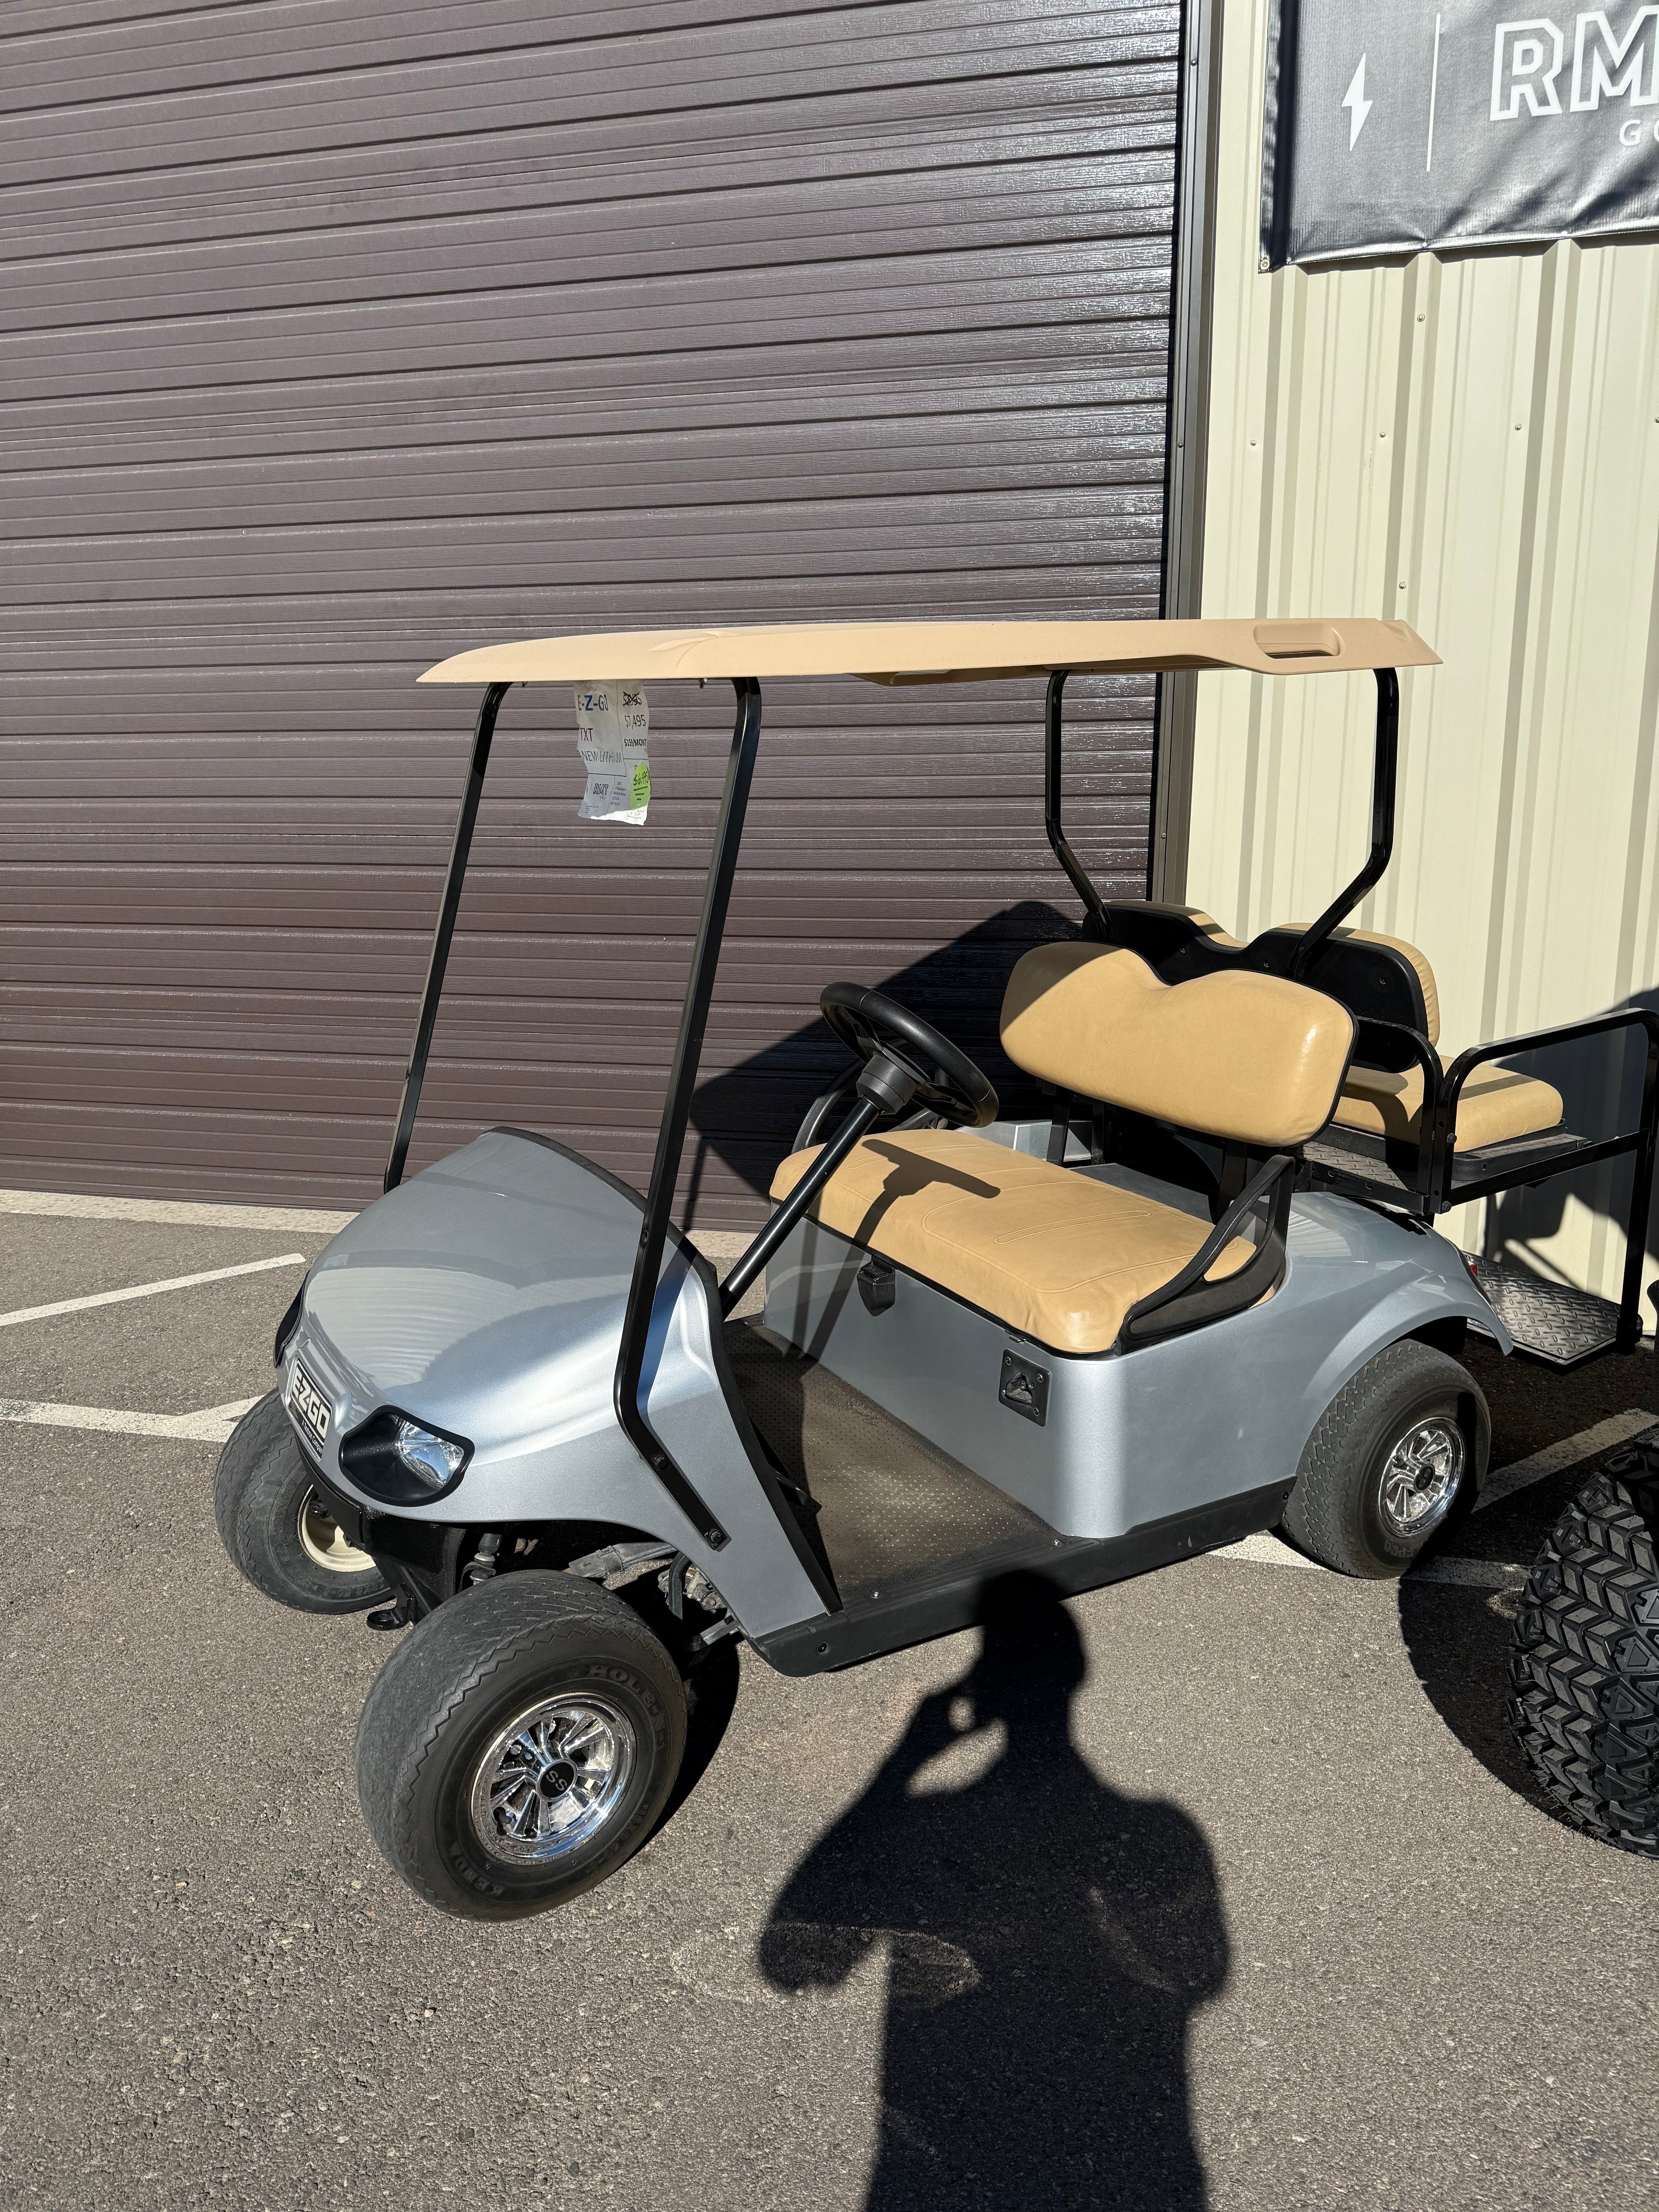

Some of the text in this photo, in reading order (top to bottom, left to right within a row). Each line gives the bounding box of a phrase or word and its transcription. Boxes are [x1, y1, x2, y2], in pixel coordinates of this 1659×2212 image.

[1619, 119, 1659, 146] G
[624, 714, 646, 729] $7,495
[580, 728, 593, 741] TXT
[582, 750, 622, 763] NEW LITHIUM
[593, 783, 609, 795] RMT
[546, 1770, 568, 1791] SS
